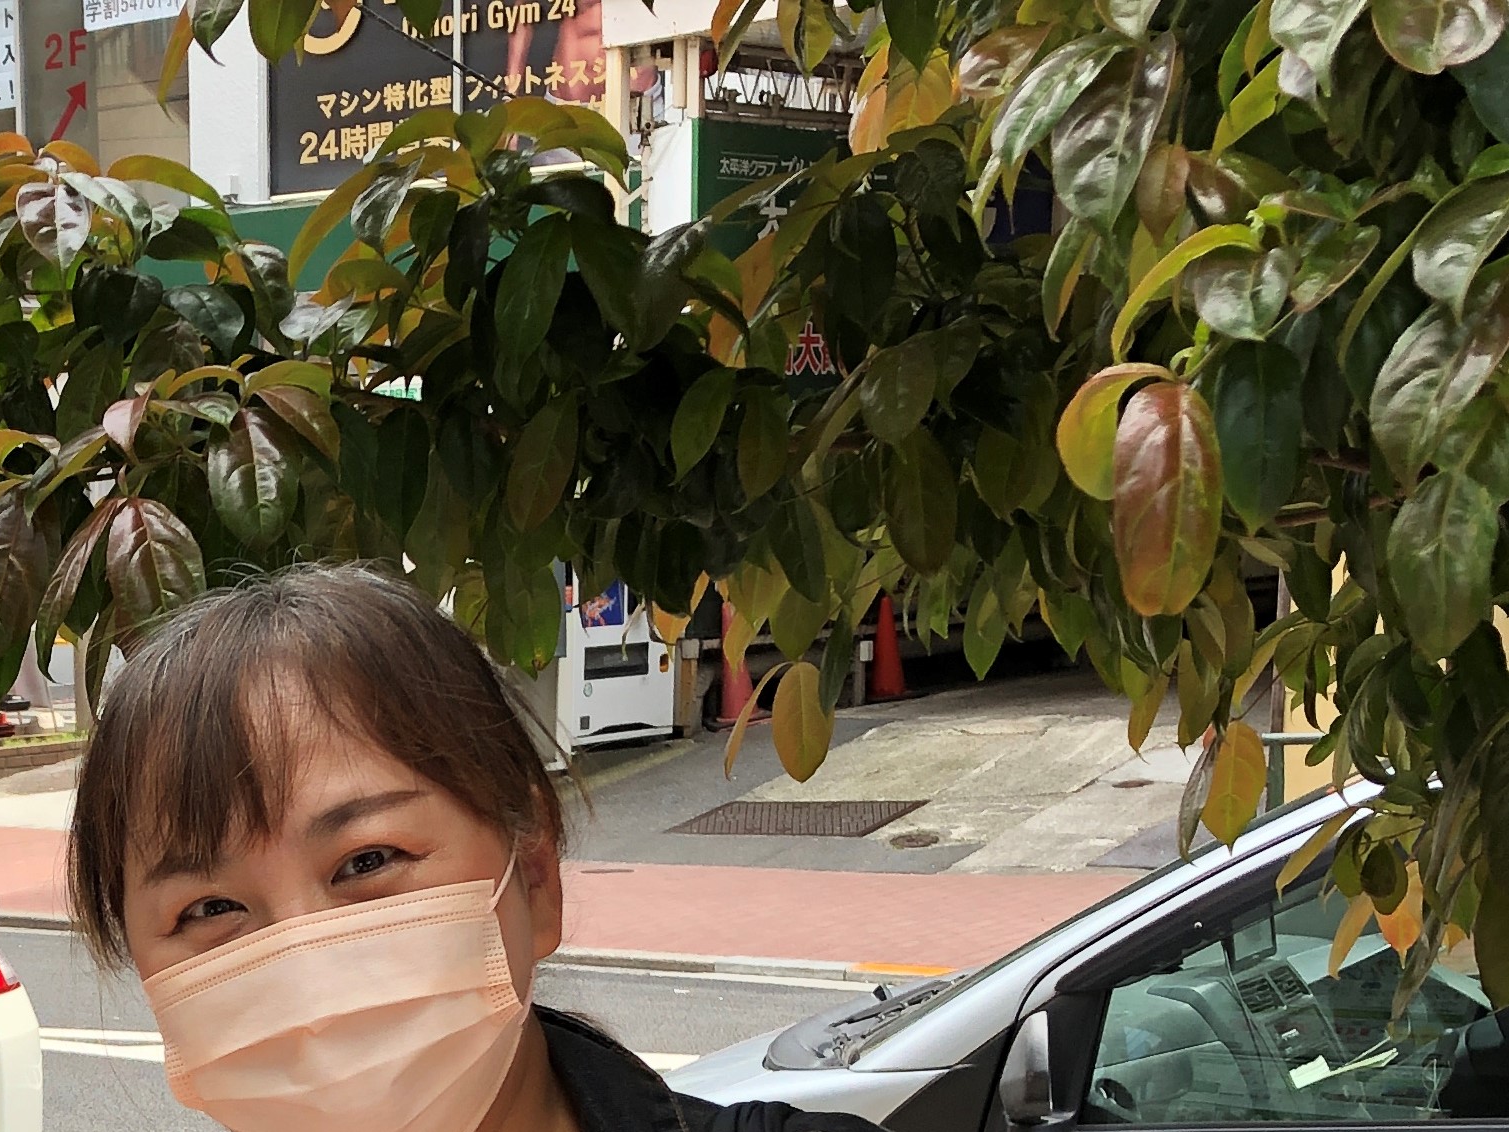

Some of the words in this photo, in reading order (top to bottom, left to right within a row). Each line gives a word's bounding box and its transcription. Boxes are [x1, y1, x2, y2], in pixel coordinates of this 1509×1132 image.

[487, 0, 541, 33] Gym
[547, 0, 577, 21] 24
[45, 29, 87, 71] 2F
[317, 75, 454, 119] マシン特化型
